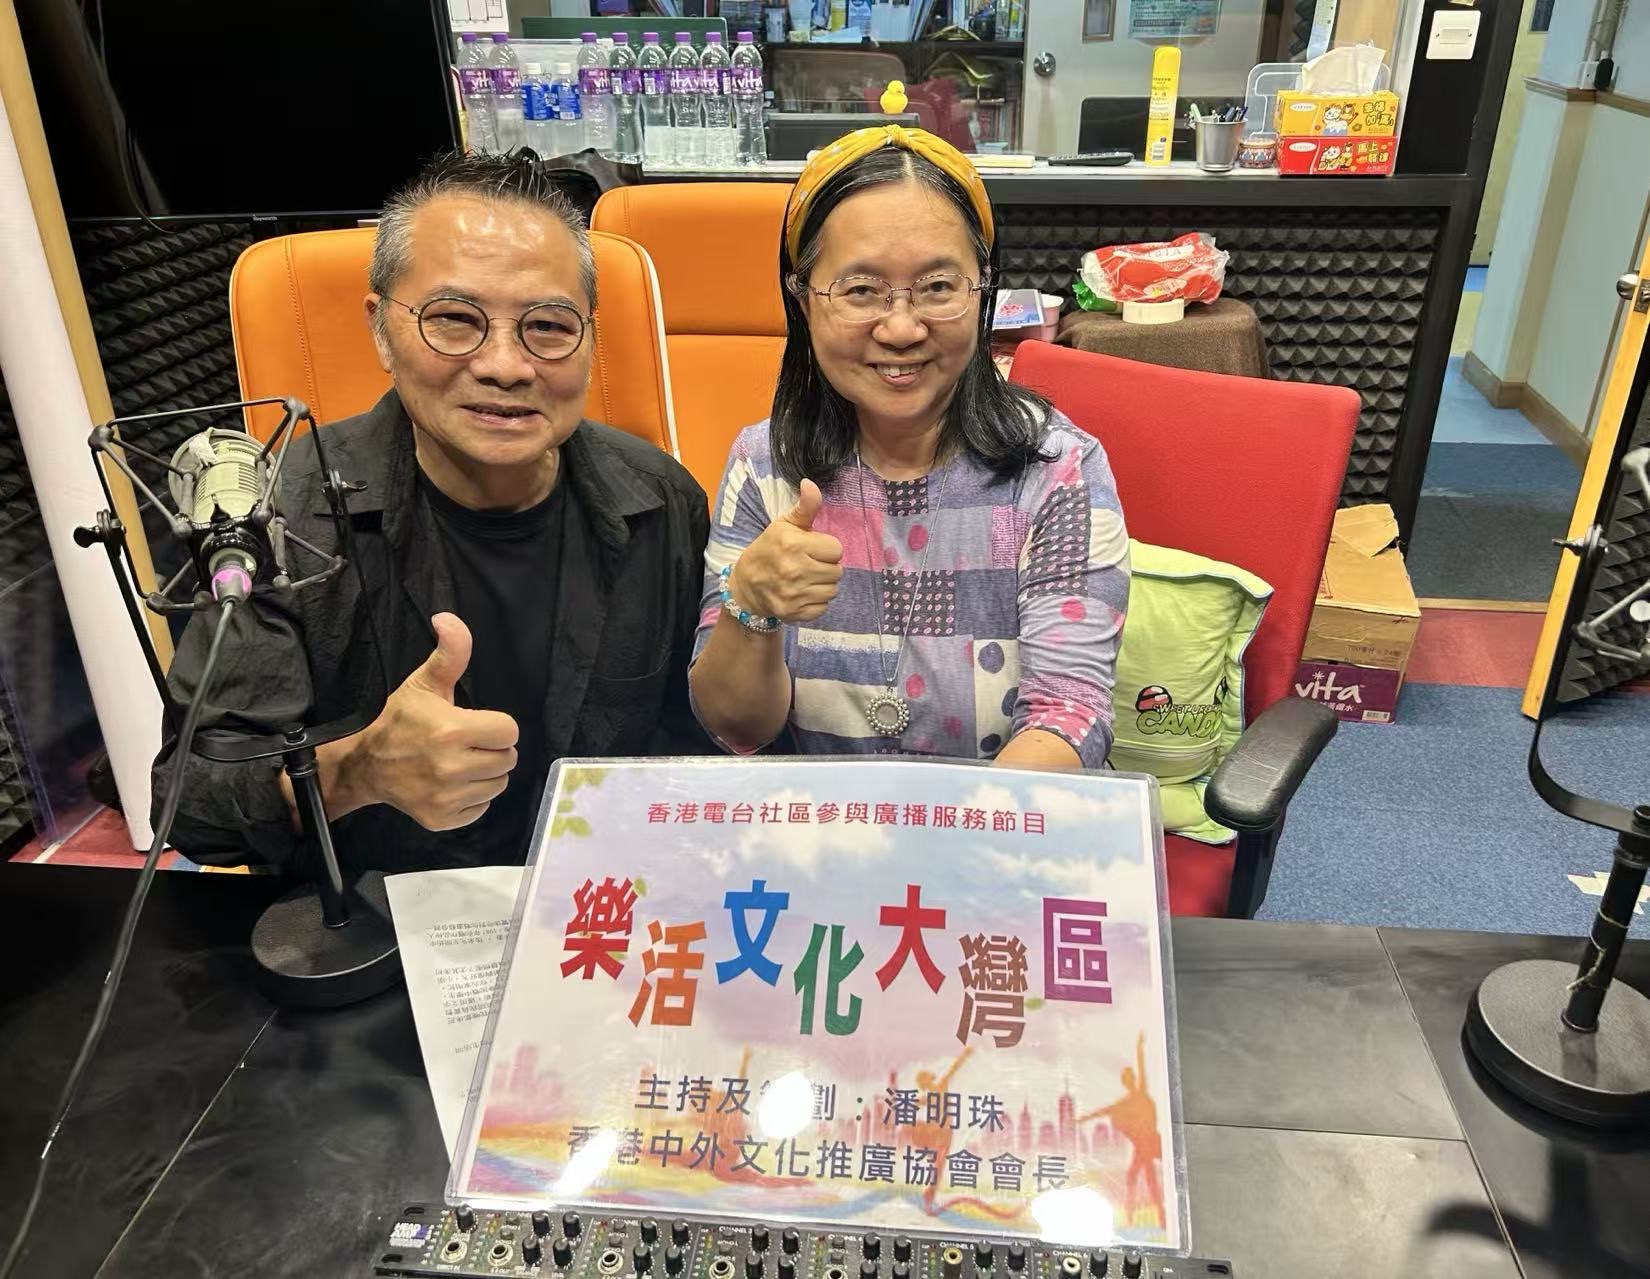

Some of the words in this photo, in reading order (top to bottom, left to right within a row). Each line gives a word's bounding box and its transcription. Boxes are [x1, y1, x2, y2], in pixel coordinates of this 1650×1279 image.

[1295, 671, 1362, 703] vita
[647, 802, 1046, 835] 香港電台社區參與廣播服務節目
[560, 877, 1113, 1049] 樂活文化大灣區
